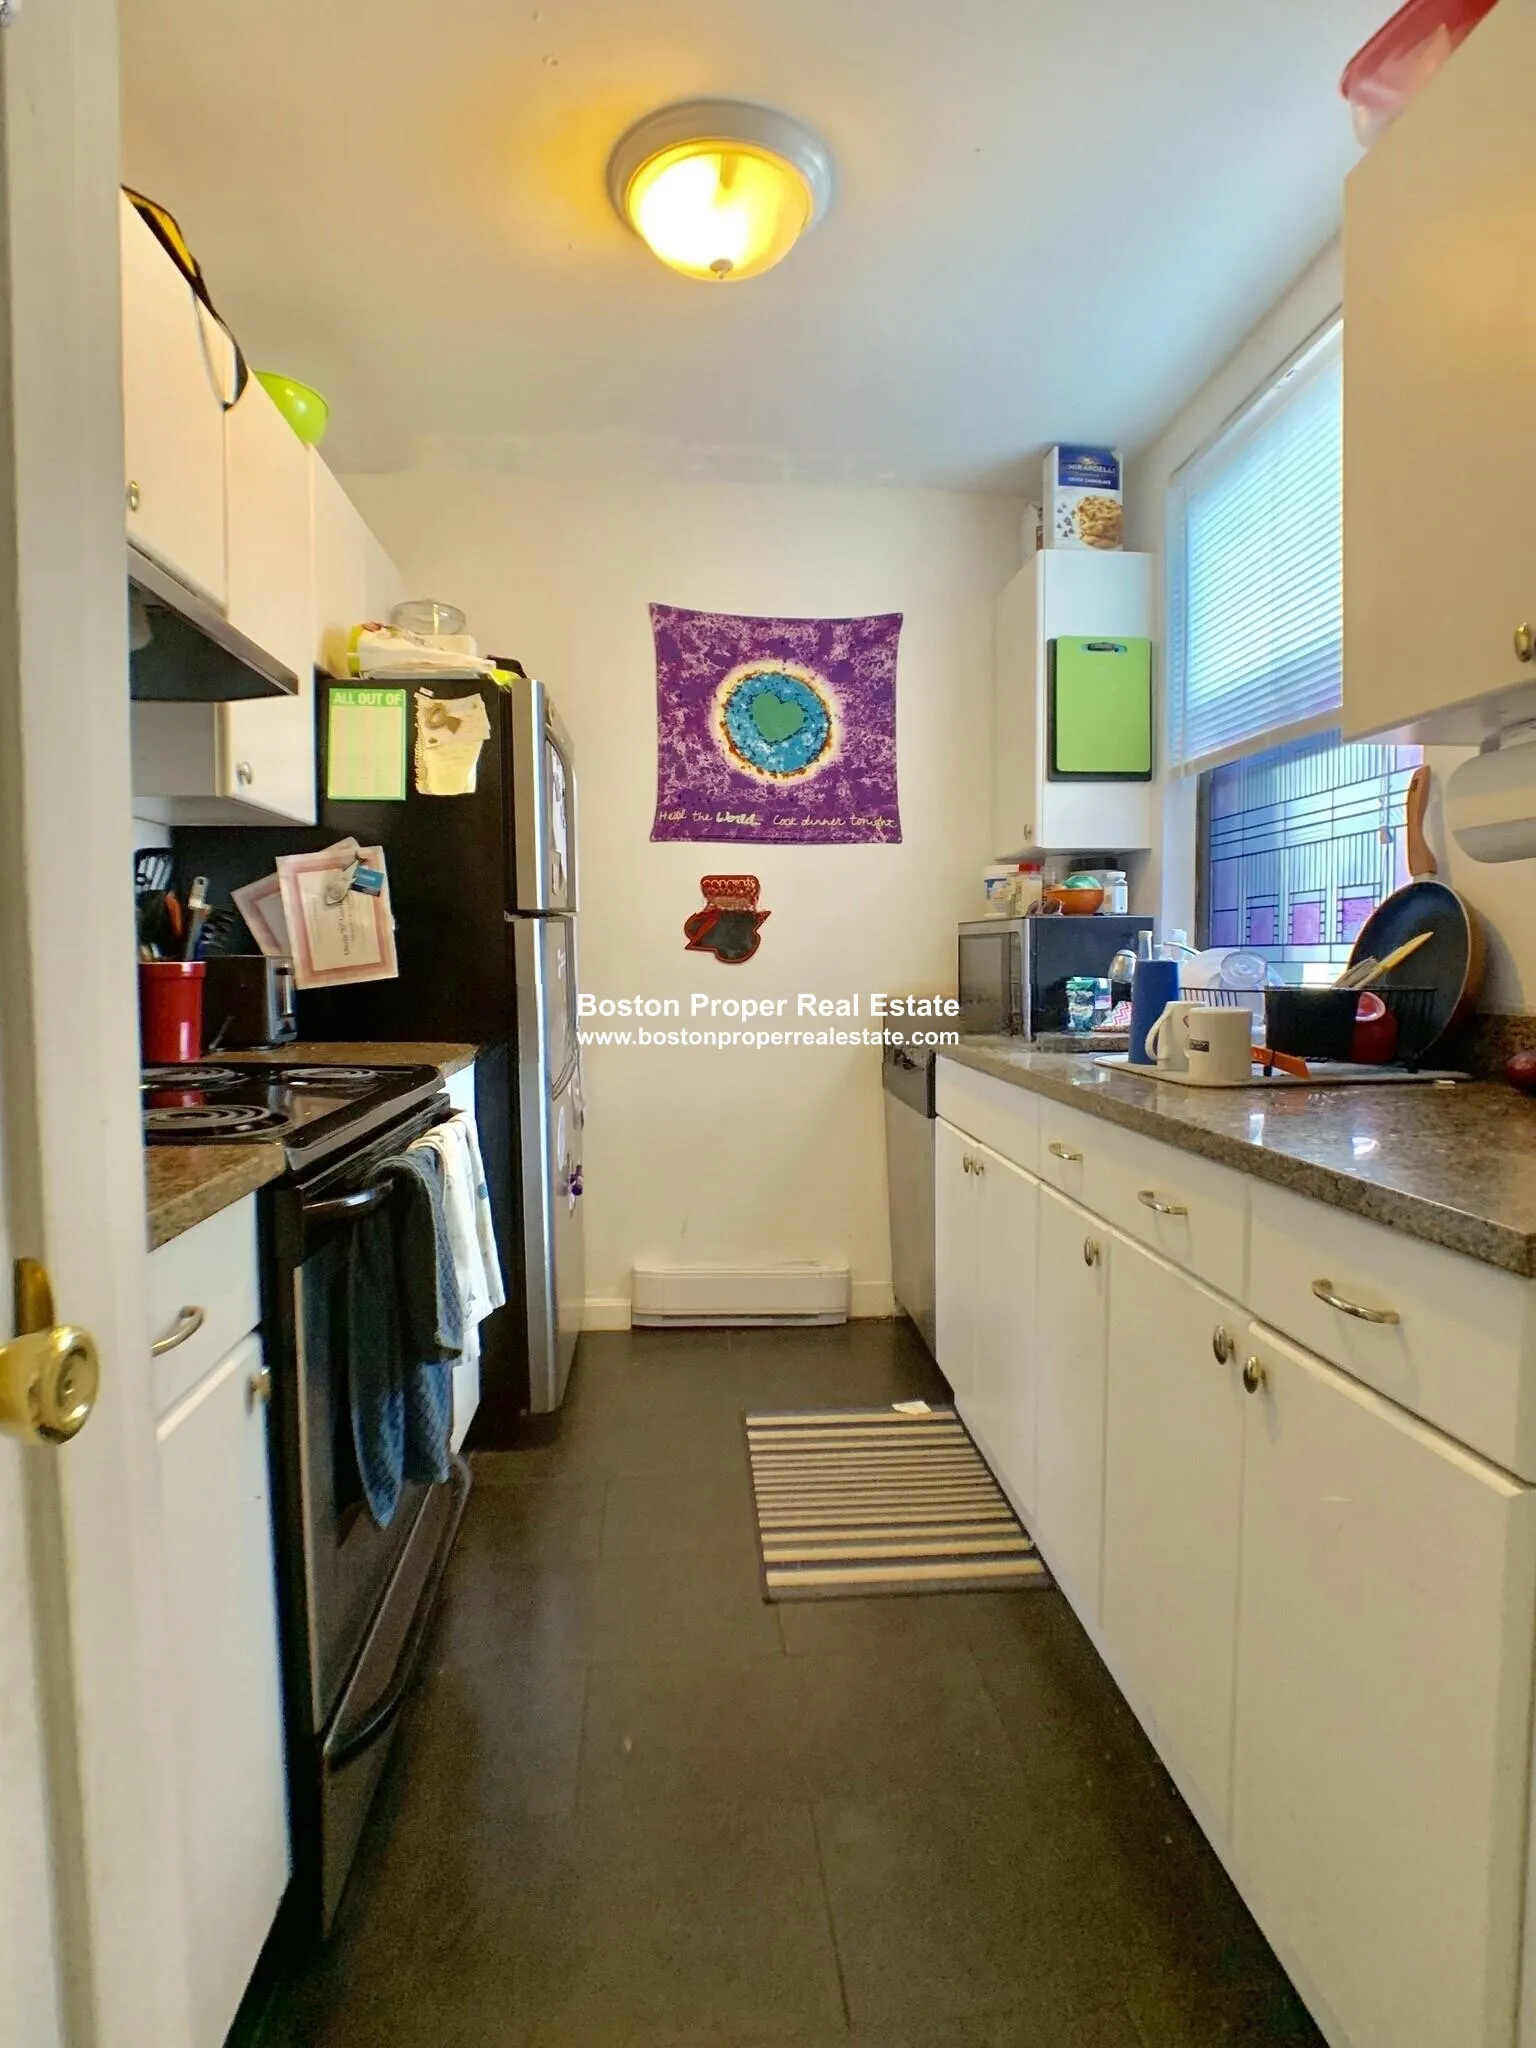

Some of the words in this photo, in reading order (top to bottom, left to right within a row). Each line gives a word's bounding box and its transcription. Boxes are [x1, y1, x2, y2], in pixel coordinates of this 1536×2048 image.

[334, 692, 354, 705] ALL
[358, 693, 382, 705] OUT
[385, 694, 403, 705] OF
[692, 810, 713, 822] the
[773, 815, 798, 826] Cook
[801, 814, 847, 827] dinner
